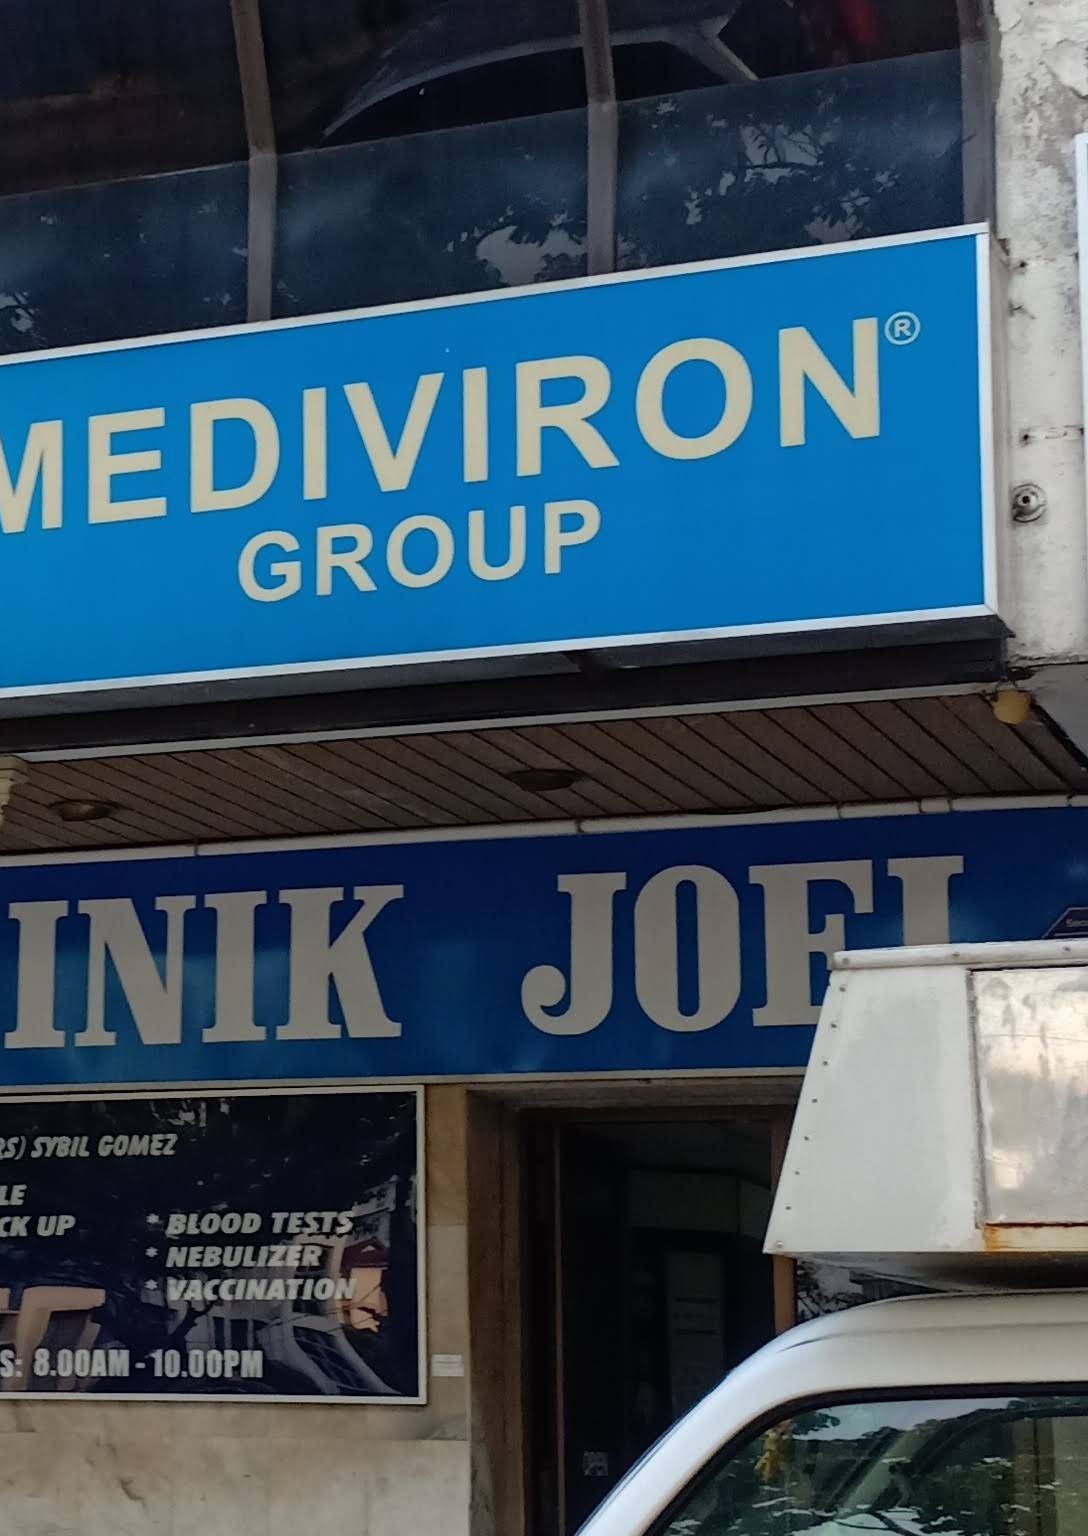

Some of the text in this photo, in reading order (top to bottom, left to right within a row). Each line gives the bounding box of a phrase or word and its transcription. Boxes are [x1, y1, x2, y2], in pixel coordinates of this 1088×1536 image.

[238, 499, 601, 602] GROUP
[30, 1135, 90, 1159] SYBIL
[98, 1133, 178, 1157] GOMEZ
[36, 1214, 76, 1236] UP
[165, 1211, 355, 1236] BLOOD TESTS
[165, 1245, 323, 1268] NEBULIZER
[166, 1278, 357, 1301] VACCINATION
[33, 1349, 130, 1378] 8.00AM
[151, 1349, 263, 1378] 10.00PM
